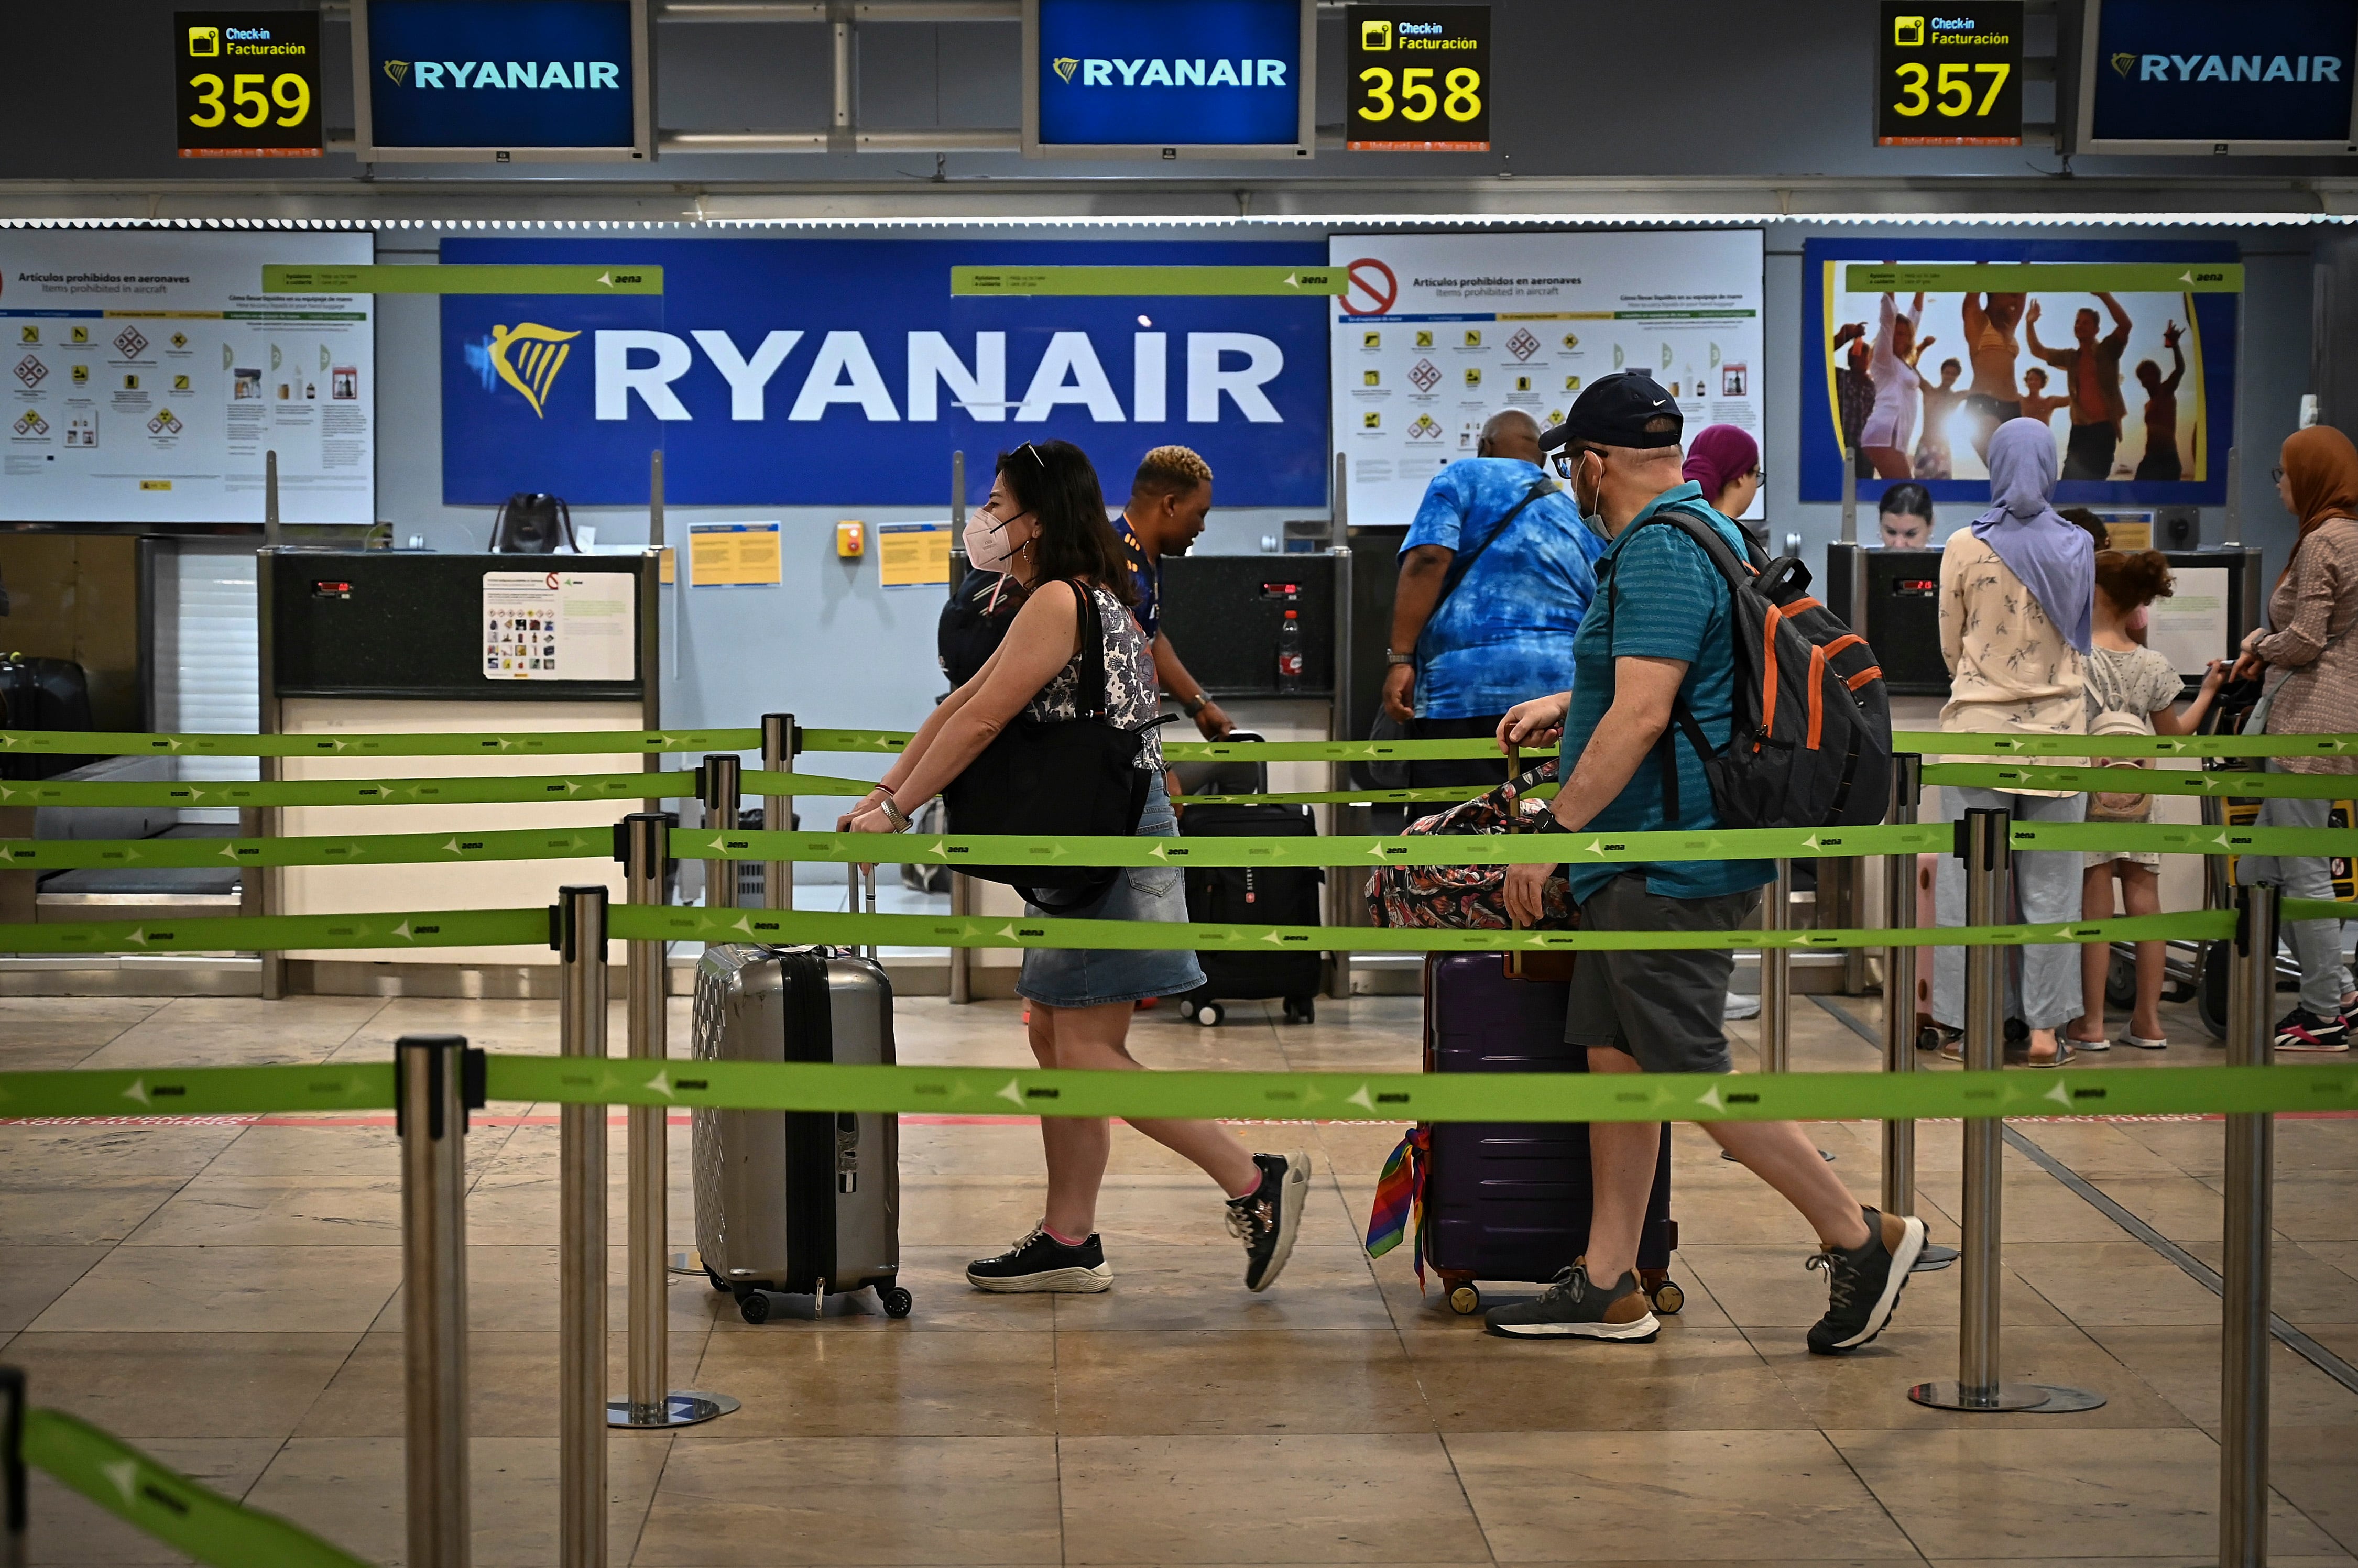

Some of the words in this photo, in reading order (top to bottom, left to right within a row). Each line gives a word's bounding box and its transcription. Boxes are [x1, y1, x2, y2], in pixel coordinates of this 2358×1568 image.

[1399, 23, 1442, 34] Check-in
[1932, 18, 1974, 29] Check-in
[226, 28, 269, 39] Check-in
[1932, 31, 2008, 44] Facturación
[227, 43, 305, 54] Facturación
[1400, 37, 1477, 49] Facturación
[1084, 59, 1286, 85] RYANAIR
[2141, 55, 2340, 81] RYANAIR
[414, 62, 619, 88] RYANAIR
[1358, 68, 1481, 121] 358
[1894, 63, 2010, 116] 357
[190, 73, 310, 127] 359
[66, 273, 121, 284] prohibidos
[138, 275, 190, 283] aeronaves
[1460, 277, 1513, 288] prohibidos
[71, 284, 119, 294] prohibited
[123, 284, 131, 292] in
[134, 283, 166, 293] aircraft
[1436, 288, 1461, 297] Items
[1465, 287, 1513, 298] prohibited
[1515, 287, 1524, 295] in
[1526, 286, 1558, 295] aircraft
[595, 330, 1284, 423] RYANAIR
